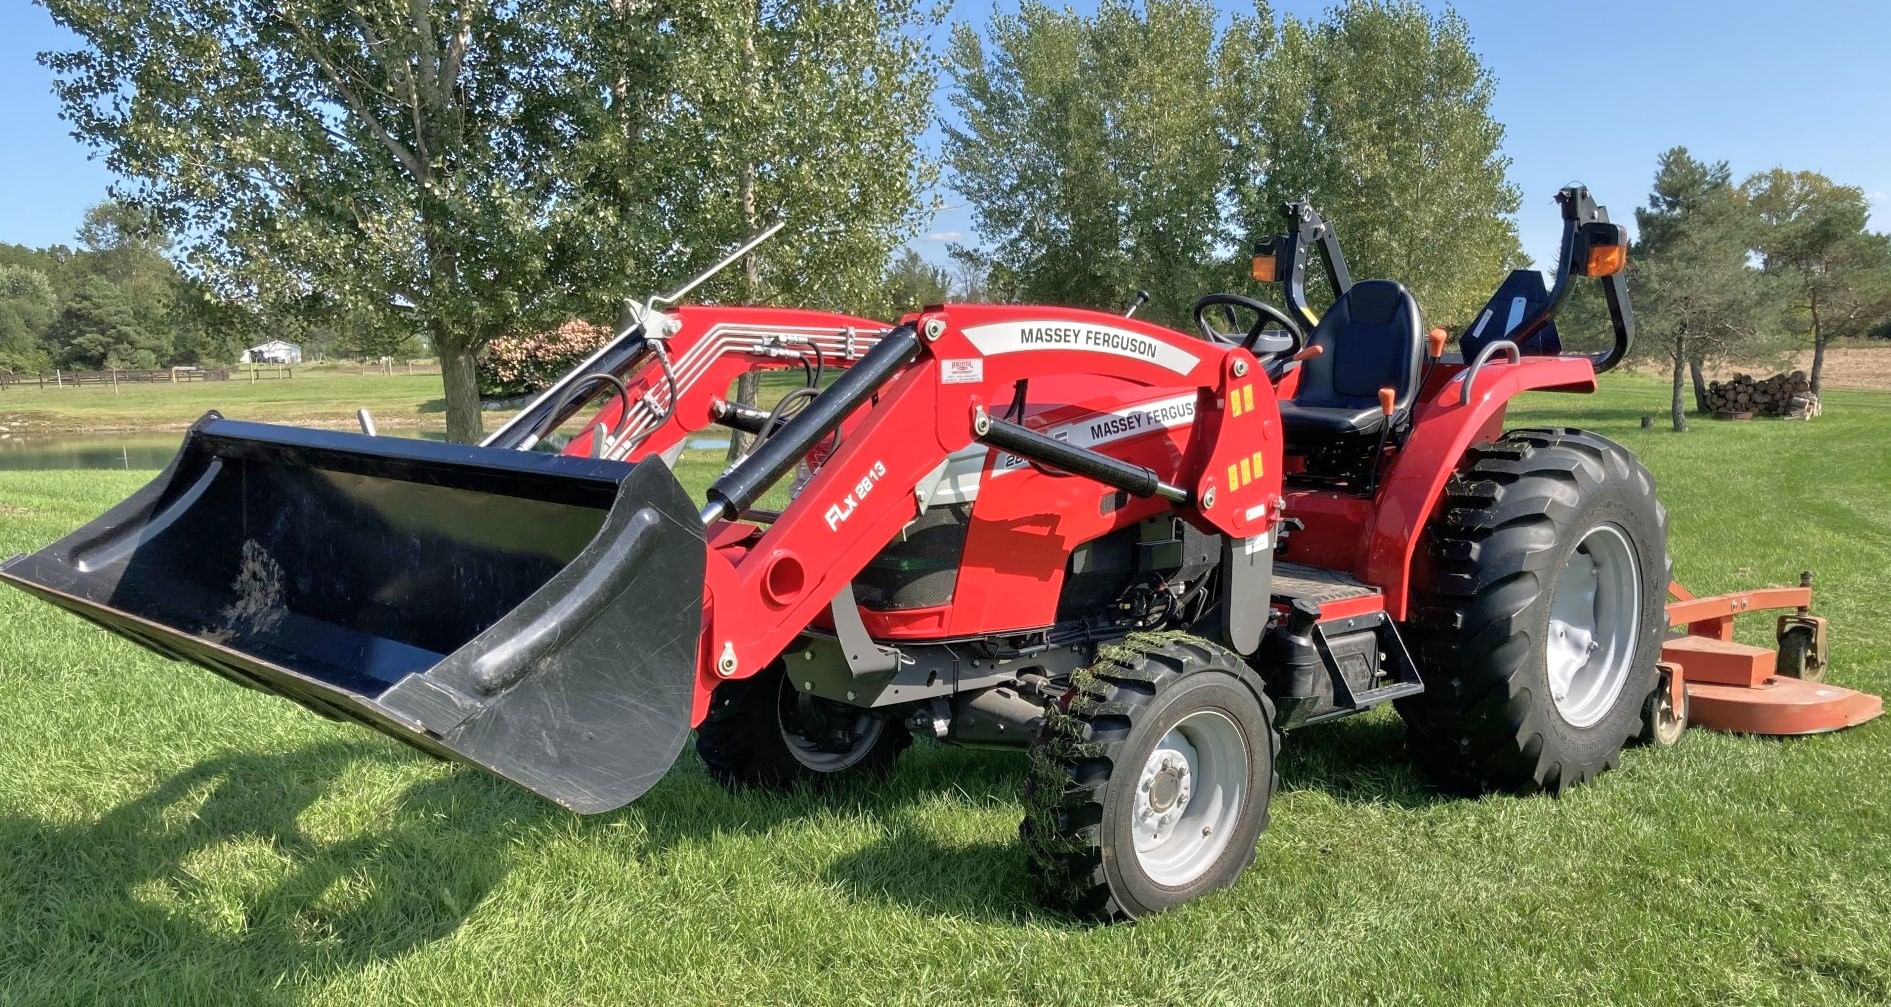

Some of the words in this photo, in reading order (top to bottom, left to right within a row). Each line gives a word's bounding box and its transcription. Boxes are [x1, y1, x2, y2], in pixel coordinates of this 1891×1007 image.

[1021, 328, 1080, 344] MASSEY
[1086, 330, 1157, 358] FERGUSON
[1090, 413, 1142, 440] MASSEY
[1146, 401, 1197, 425] FERGUS
[855, 460, 886, 500] 2813
